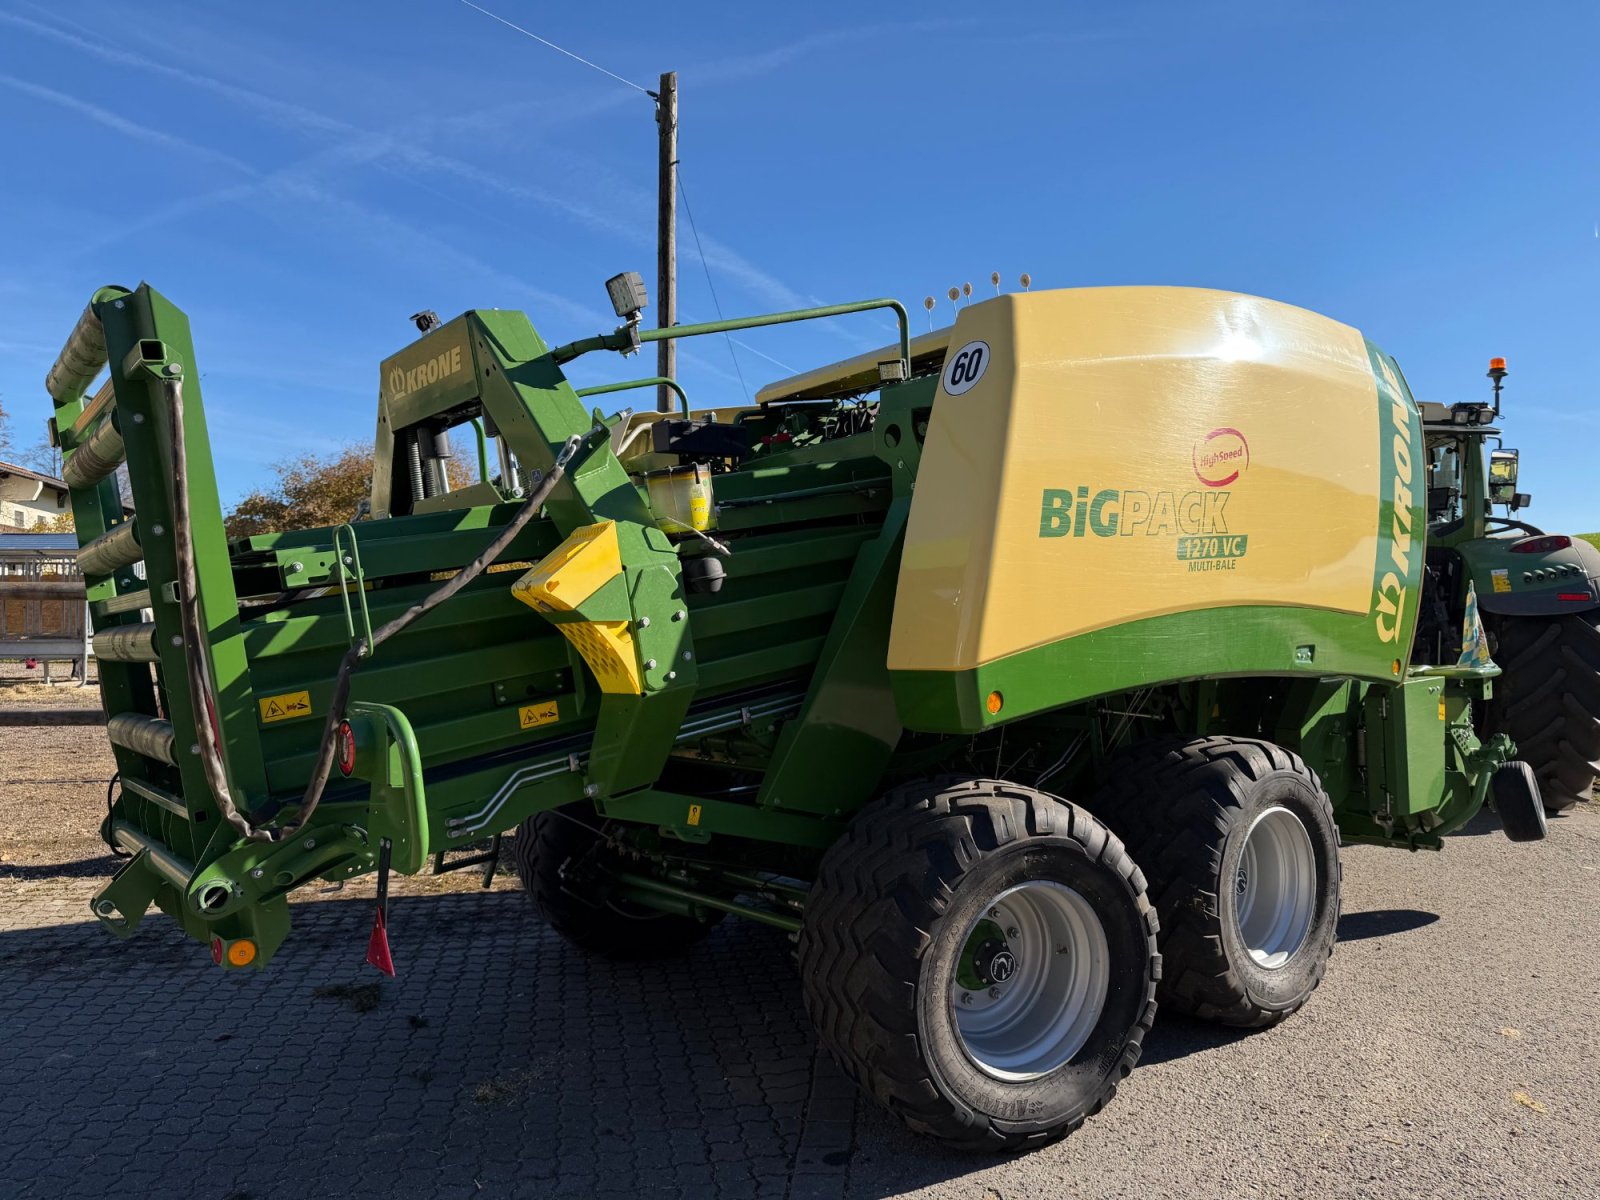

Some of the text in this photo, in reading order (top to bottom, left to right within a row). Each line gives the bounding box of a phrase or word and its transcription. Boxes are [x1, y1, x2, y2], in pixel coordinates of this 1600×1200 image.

[406, 345, 461, 394] KRONE
[951, 348, 983, 386] 60
[1376, 352, 1412, 577] KRONE
[1185, 537, 1242, 558] 1270 VC
[1188, 559, 1236, 572] MULTI-BALE
